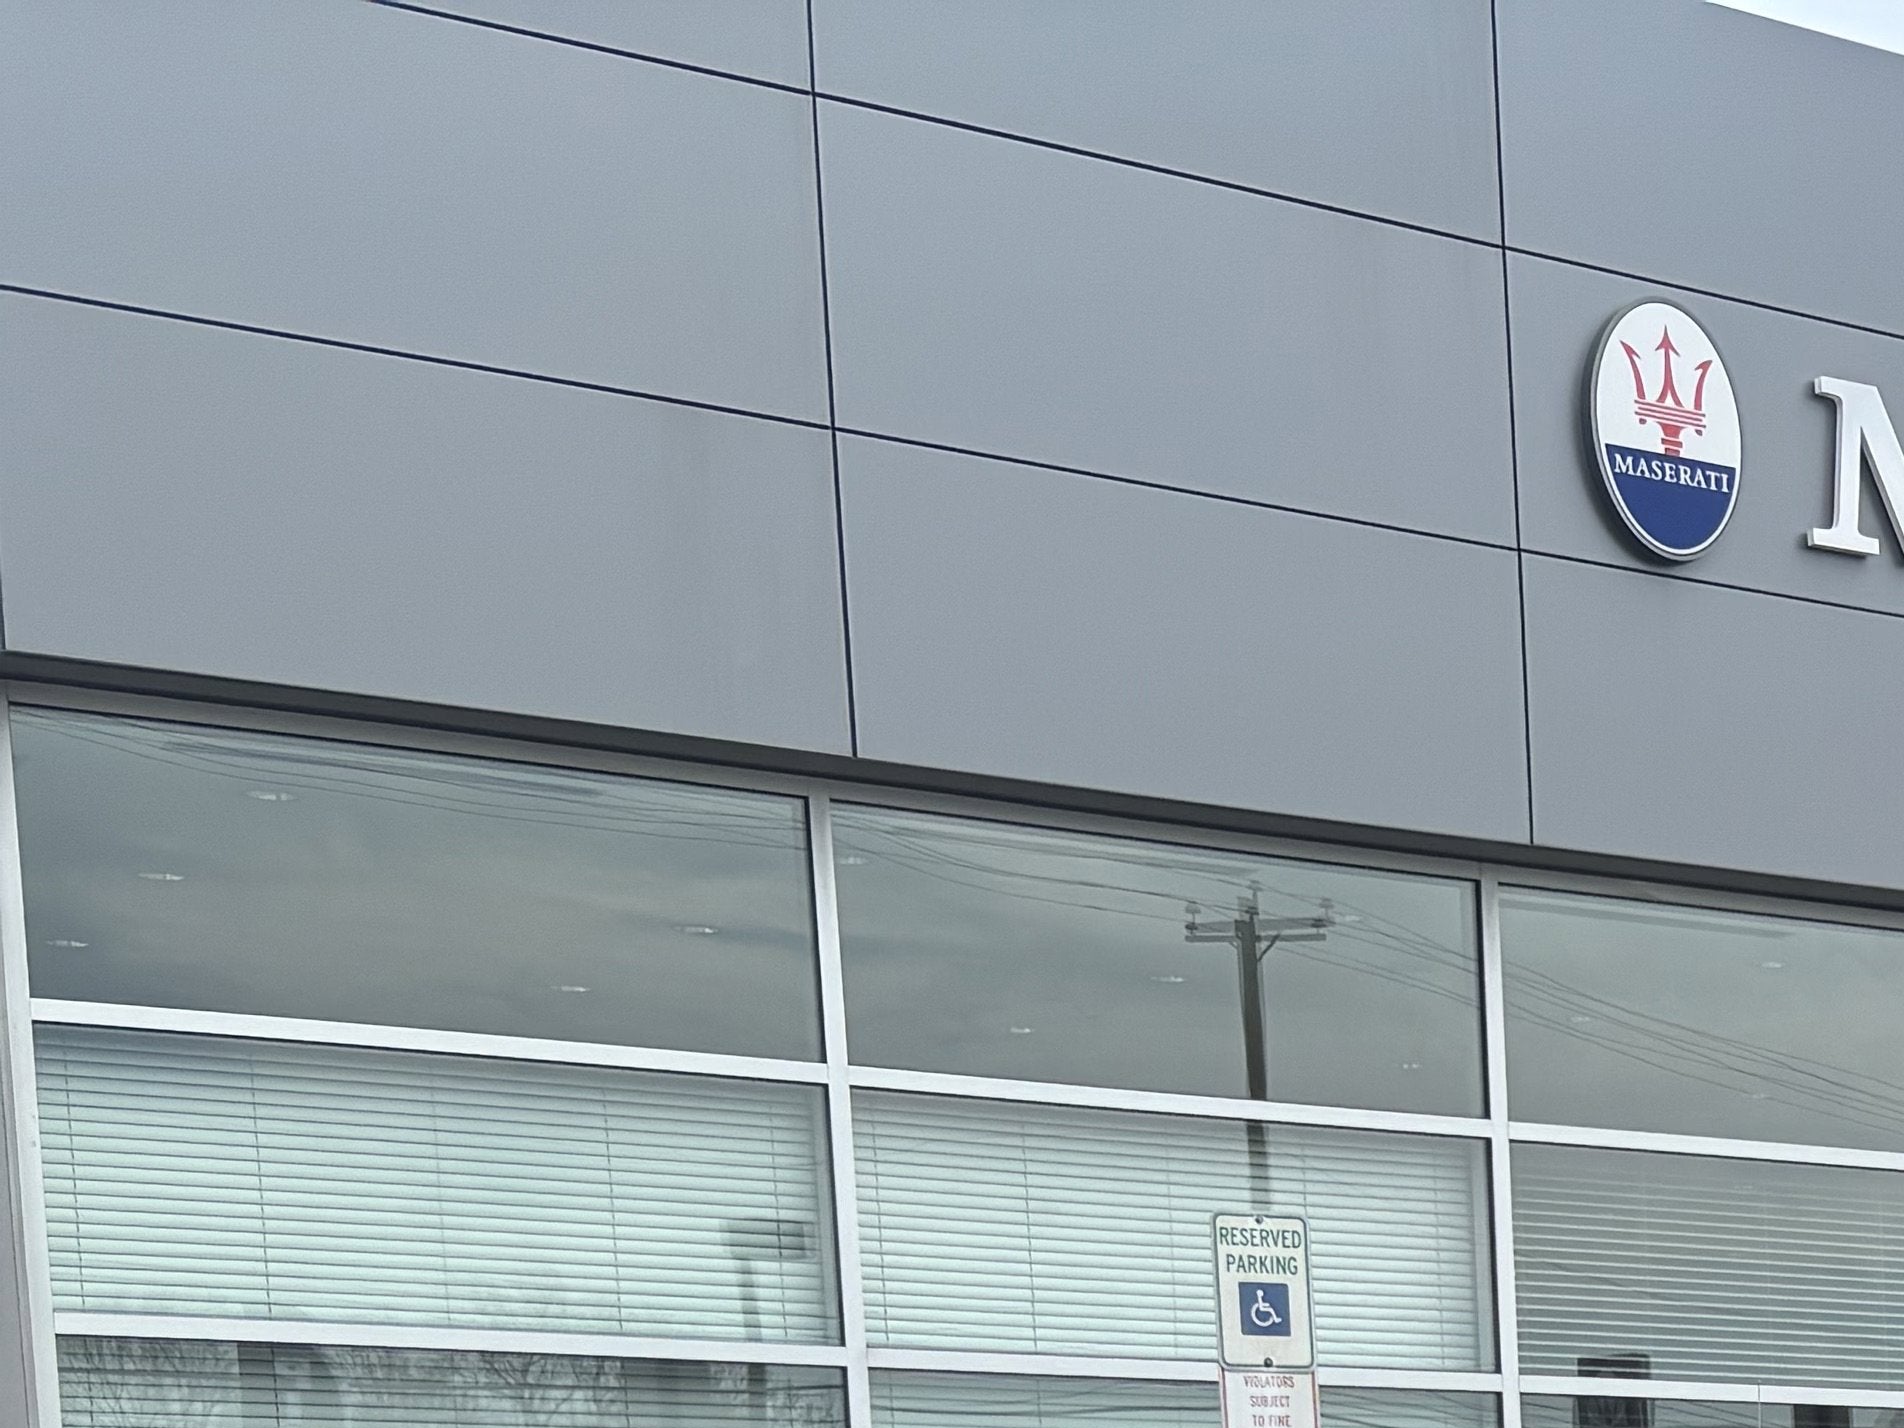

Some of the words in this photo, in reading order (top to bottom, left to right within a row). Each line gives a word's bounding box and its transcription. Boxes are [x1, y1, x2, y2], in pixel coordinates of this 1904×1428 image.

[1614, 453, 1730, 493] MASERATI
[1219, 1226, 1302, 1249] RESERVED
[1226, 1253, 1298, 1276] PARKING
[1243, 1375, 1295, 1388] VIOLATORS
[1249, 1395, 1290, 1408] SUBJECT
[1252, 1414, 1265, 1427] TO
[1268, 1414, 1292, 1427] FINE
